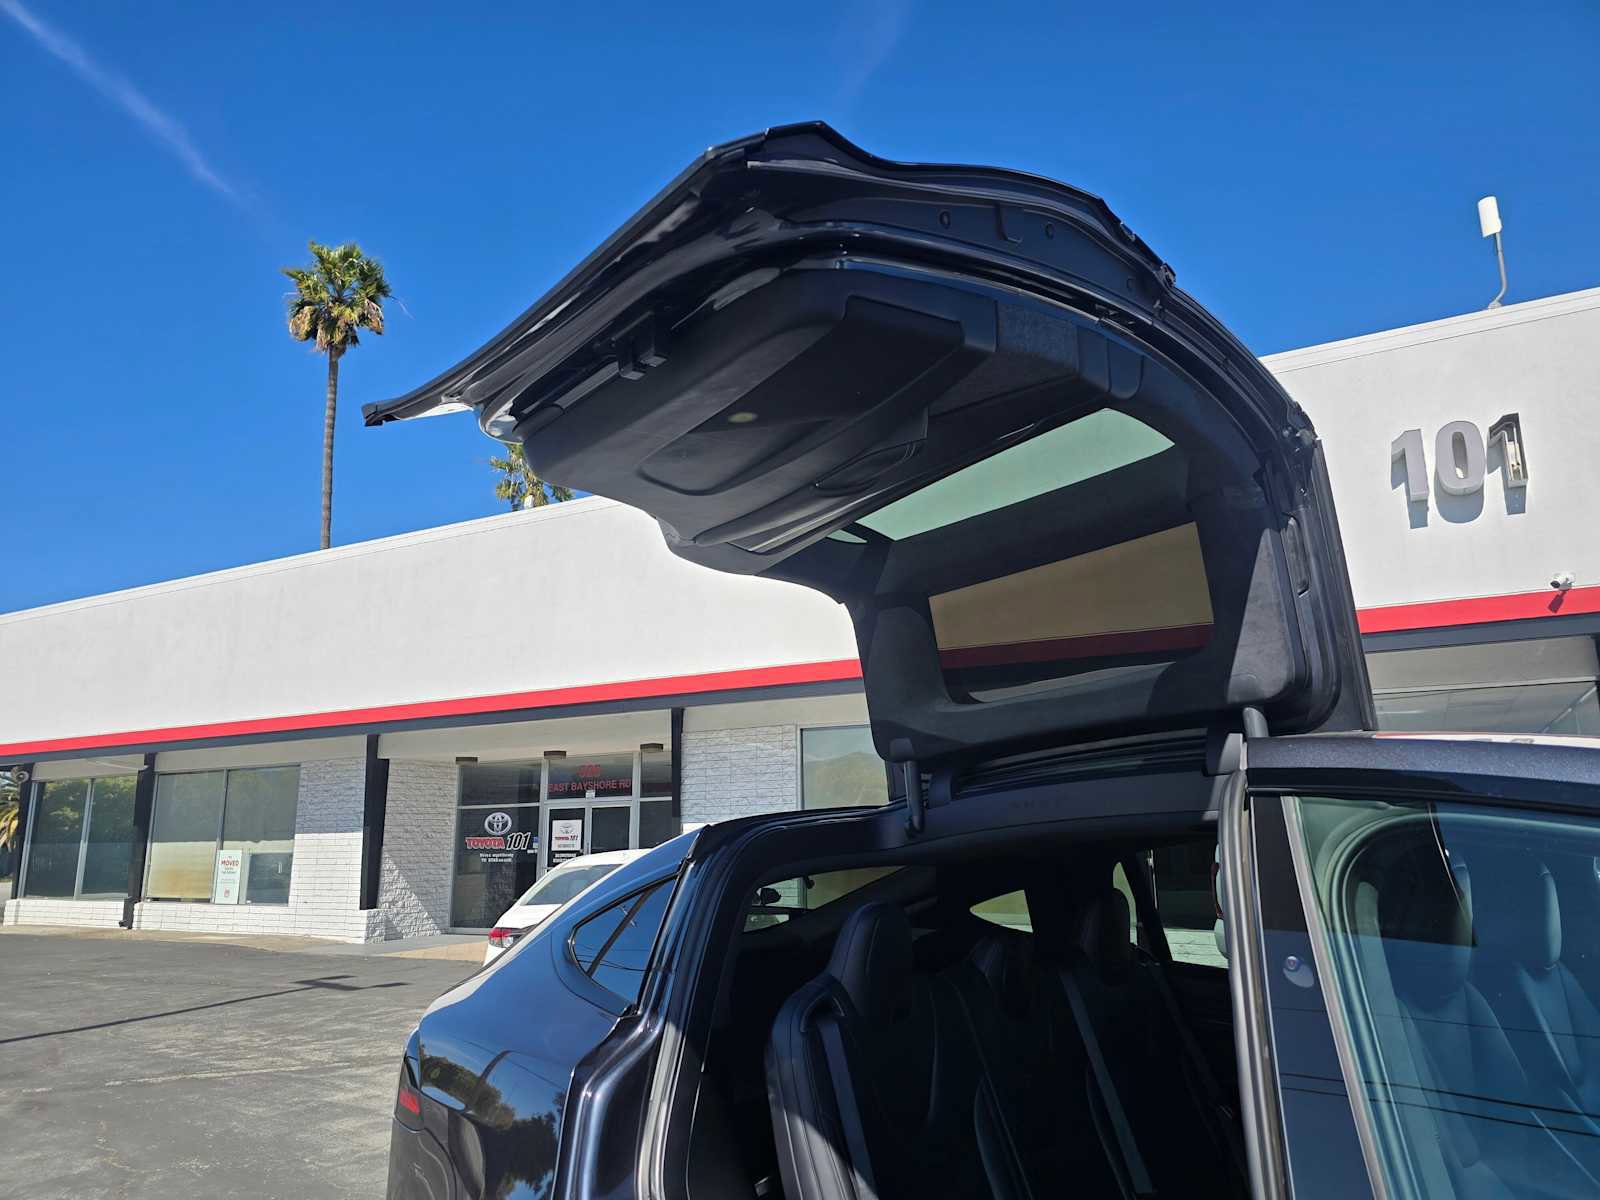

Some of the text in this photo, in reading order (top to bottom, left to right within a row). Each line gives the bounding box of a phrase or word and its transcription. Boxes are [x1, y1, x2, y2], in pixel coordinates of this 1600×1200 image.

[1390, 412, 1528, 503] 101
[548, 783, 568, 793] EAST
[571, 780, 617, 791] BAYSHORE
[465, 832, 531, 850] TOYOTA 101
